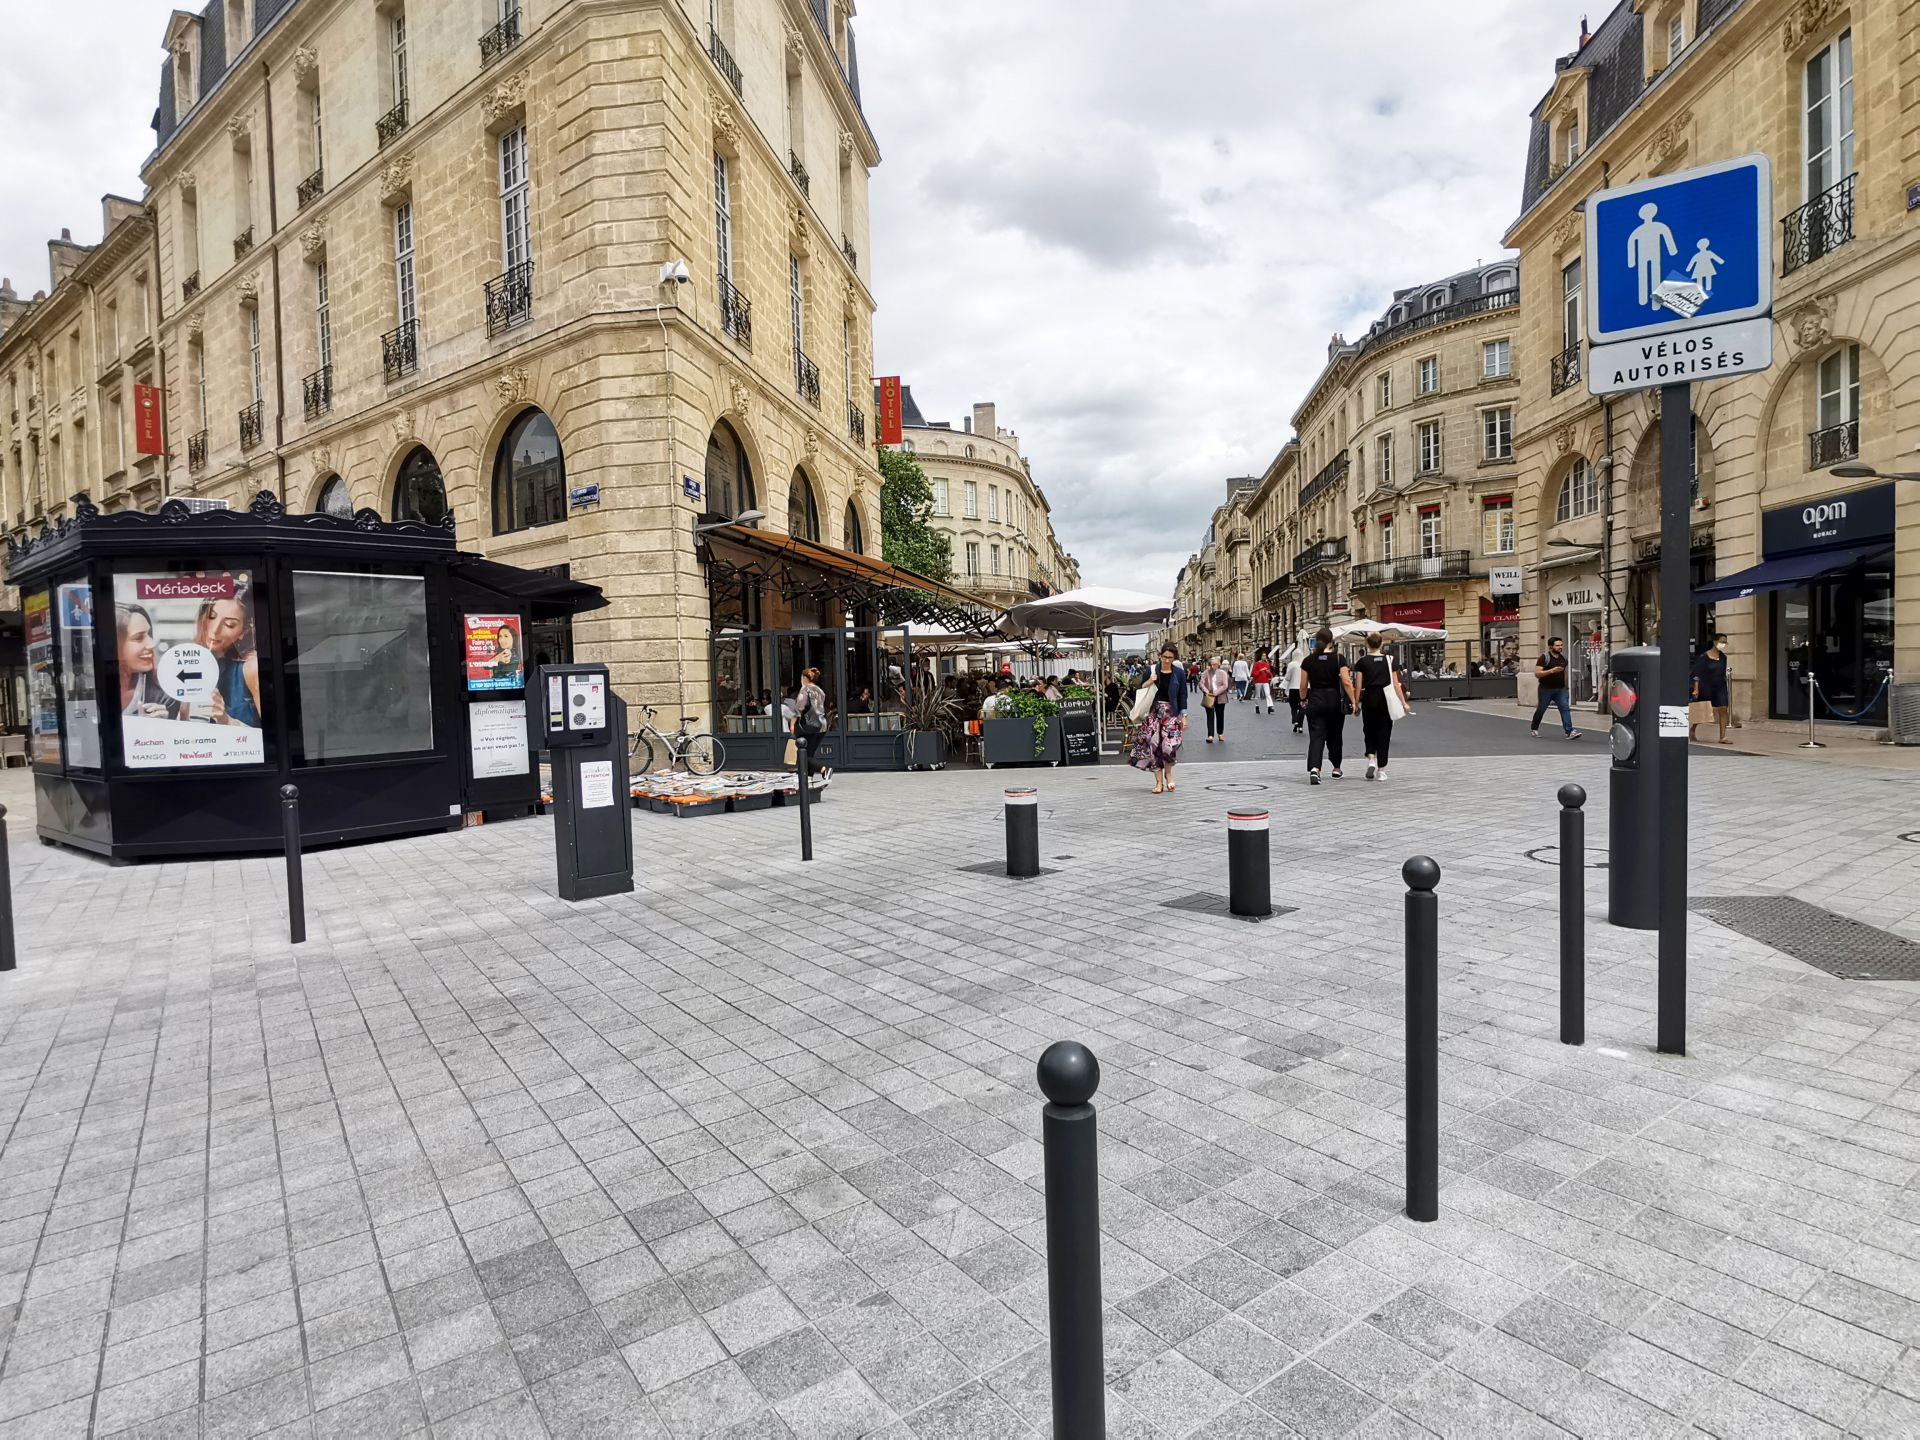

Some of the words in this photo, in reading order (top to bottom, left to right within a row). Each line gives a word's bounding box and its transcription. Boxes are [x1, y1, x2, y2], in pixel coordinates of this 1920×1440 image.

[1641, 336, 1714, 360] VÉLOS
[1613, 351, 1745, 385] AUTORISÉS
[885, 377, 895, 429] HOTEL
[141, 387, 153, 439] HOTEL
[1802, 501, 1847, 530] apm
[1813, 529, 1837, 539] MONACO
[1494, 571, 1520, 580] WEILL
[145, 582, 226, 596] Mériadeck
[1566, 589, 1593, 606] WEILL
[1395, 608, 1422, 617] CLARINS
[475, 707, 519, 717] diplomatique
[134, 738, 164, 746] Auchan
[229, 749, 261, 757] TRUFFAUT
